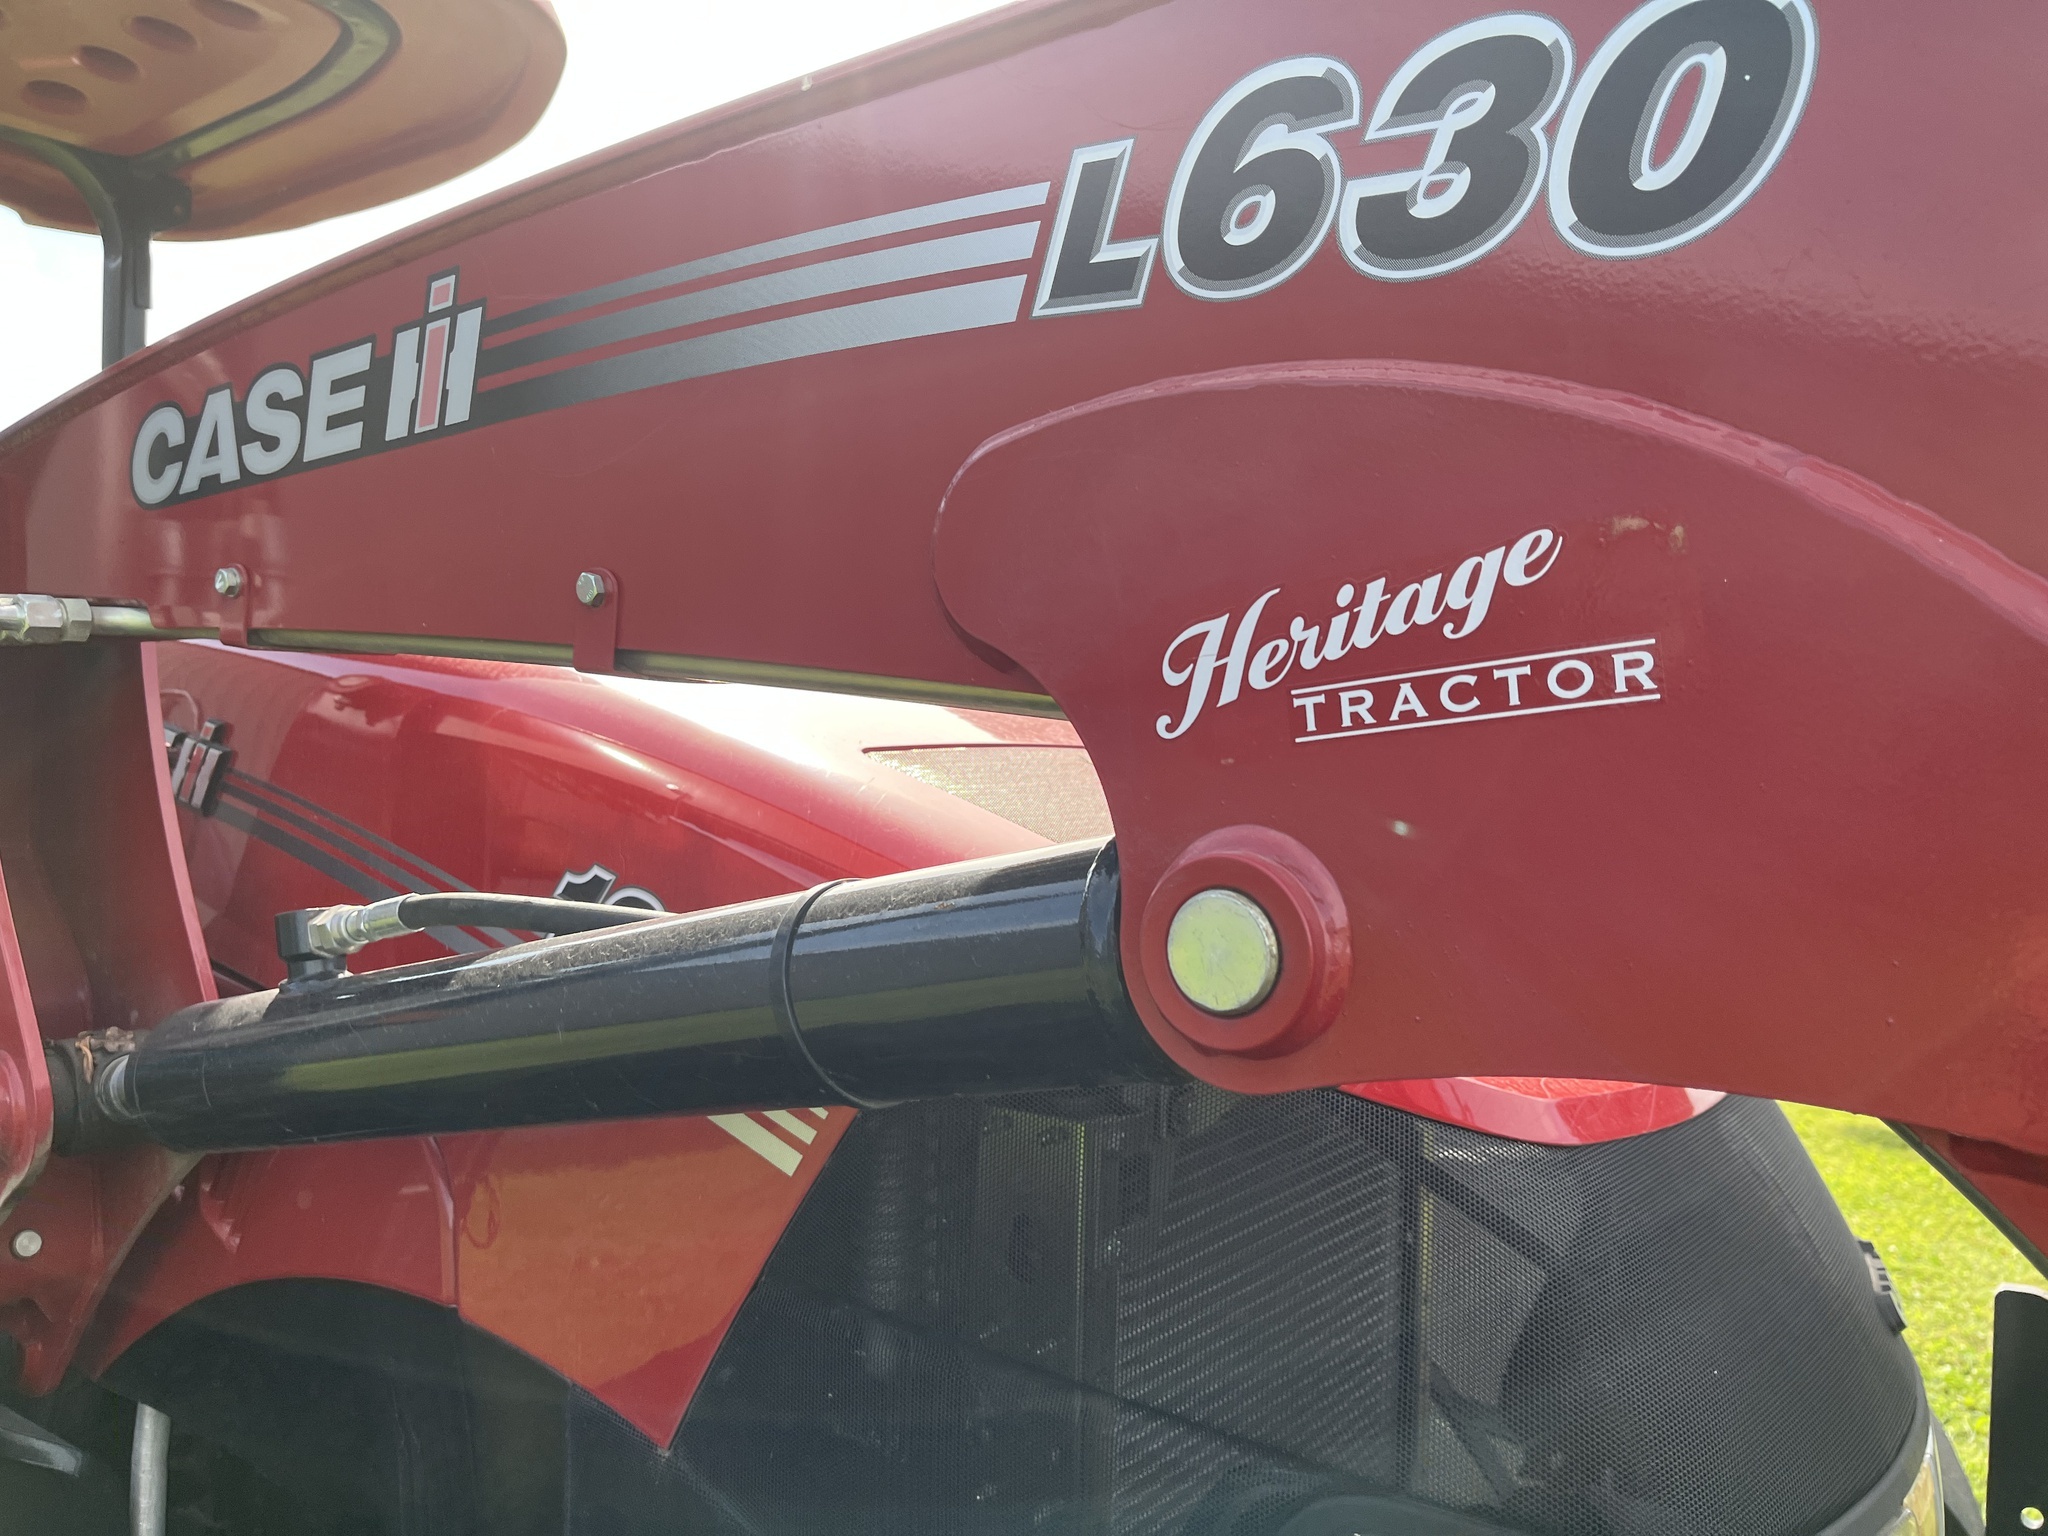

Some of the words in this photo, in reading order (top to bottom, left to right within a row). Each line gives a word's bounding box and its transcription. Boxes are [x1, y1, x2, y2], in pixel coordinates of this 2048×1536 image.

[1031, 0, 1819, 318] L630
[132, 342, 373, 504] CASE
[1156, 529, 1562, 739] Heritage
[1293, 650, 1657, 731] TRACTOR
